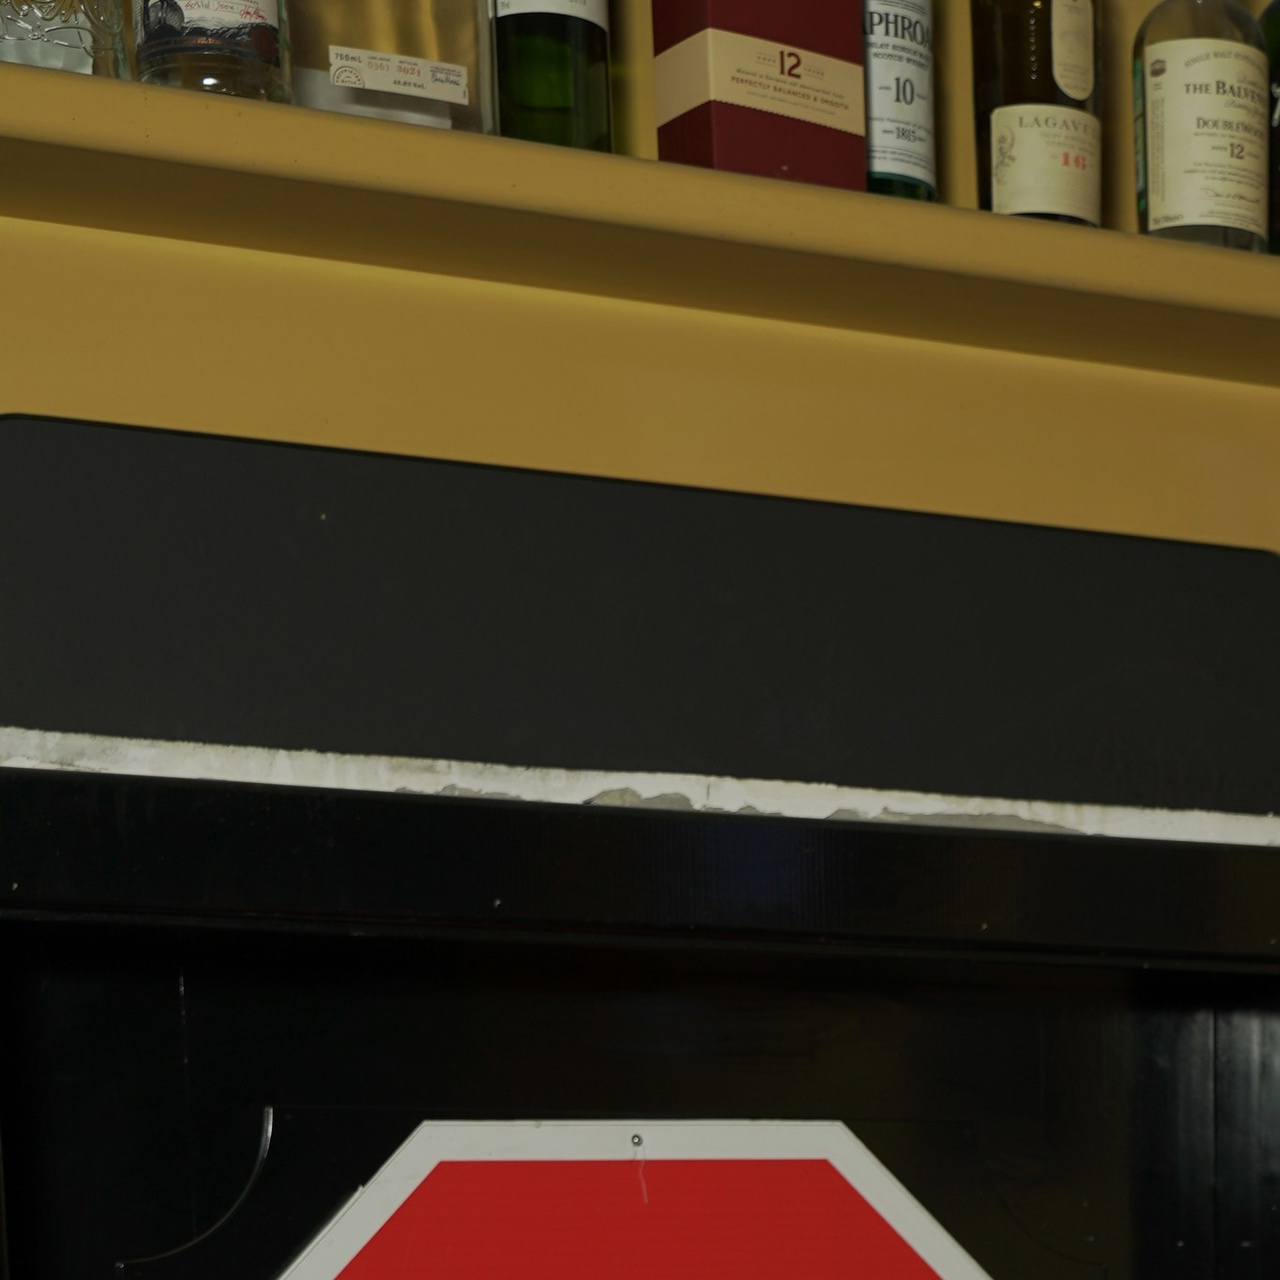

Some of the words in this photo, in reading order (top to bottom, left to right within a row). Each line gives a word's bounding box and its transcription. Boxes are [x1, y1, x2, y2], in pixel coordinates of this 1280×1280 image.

[863, 12, 929, 47] PHRO
[779, 50, 805, 79] 12
[894, 77, 914, 105] 10
[1184, 84, 1211, 95] THE
[1061, 152, 1087, 171] 16
[1229, 143, 1245, 159] 12
